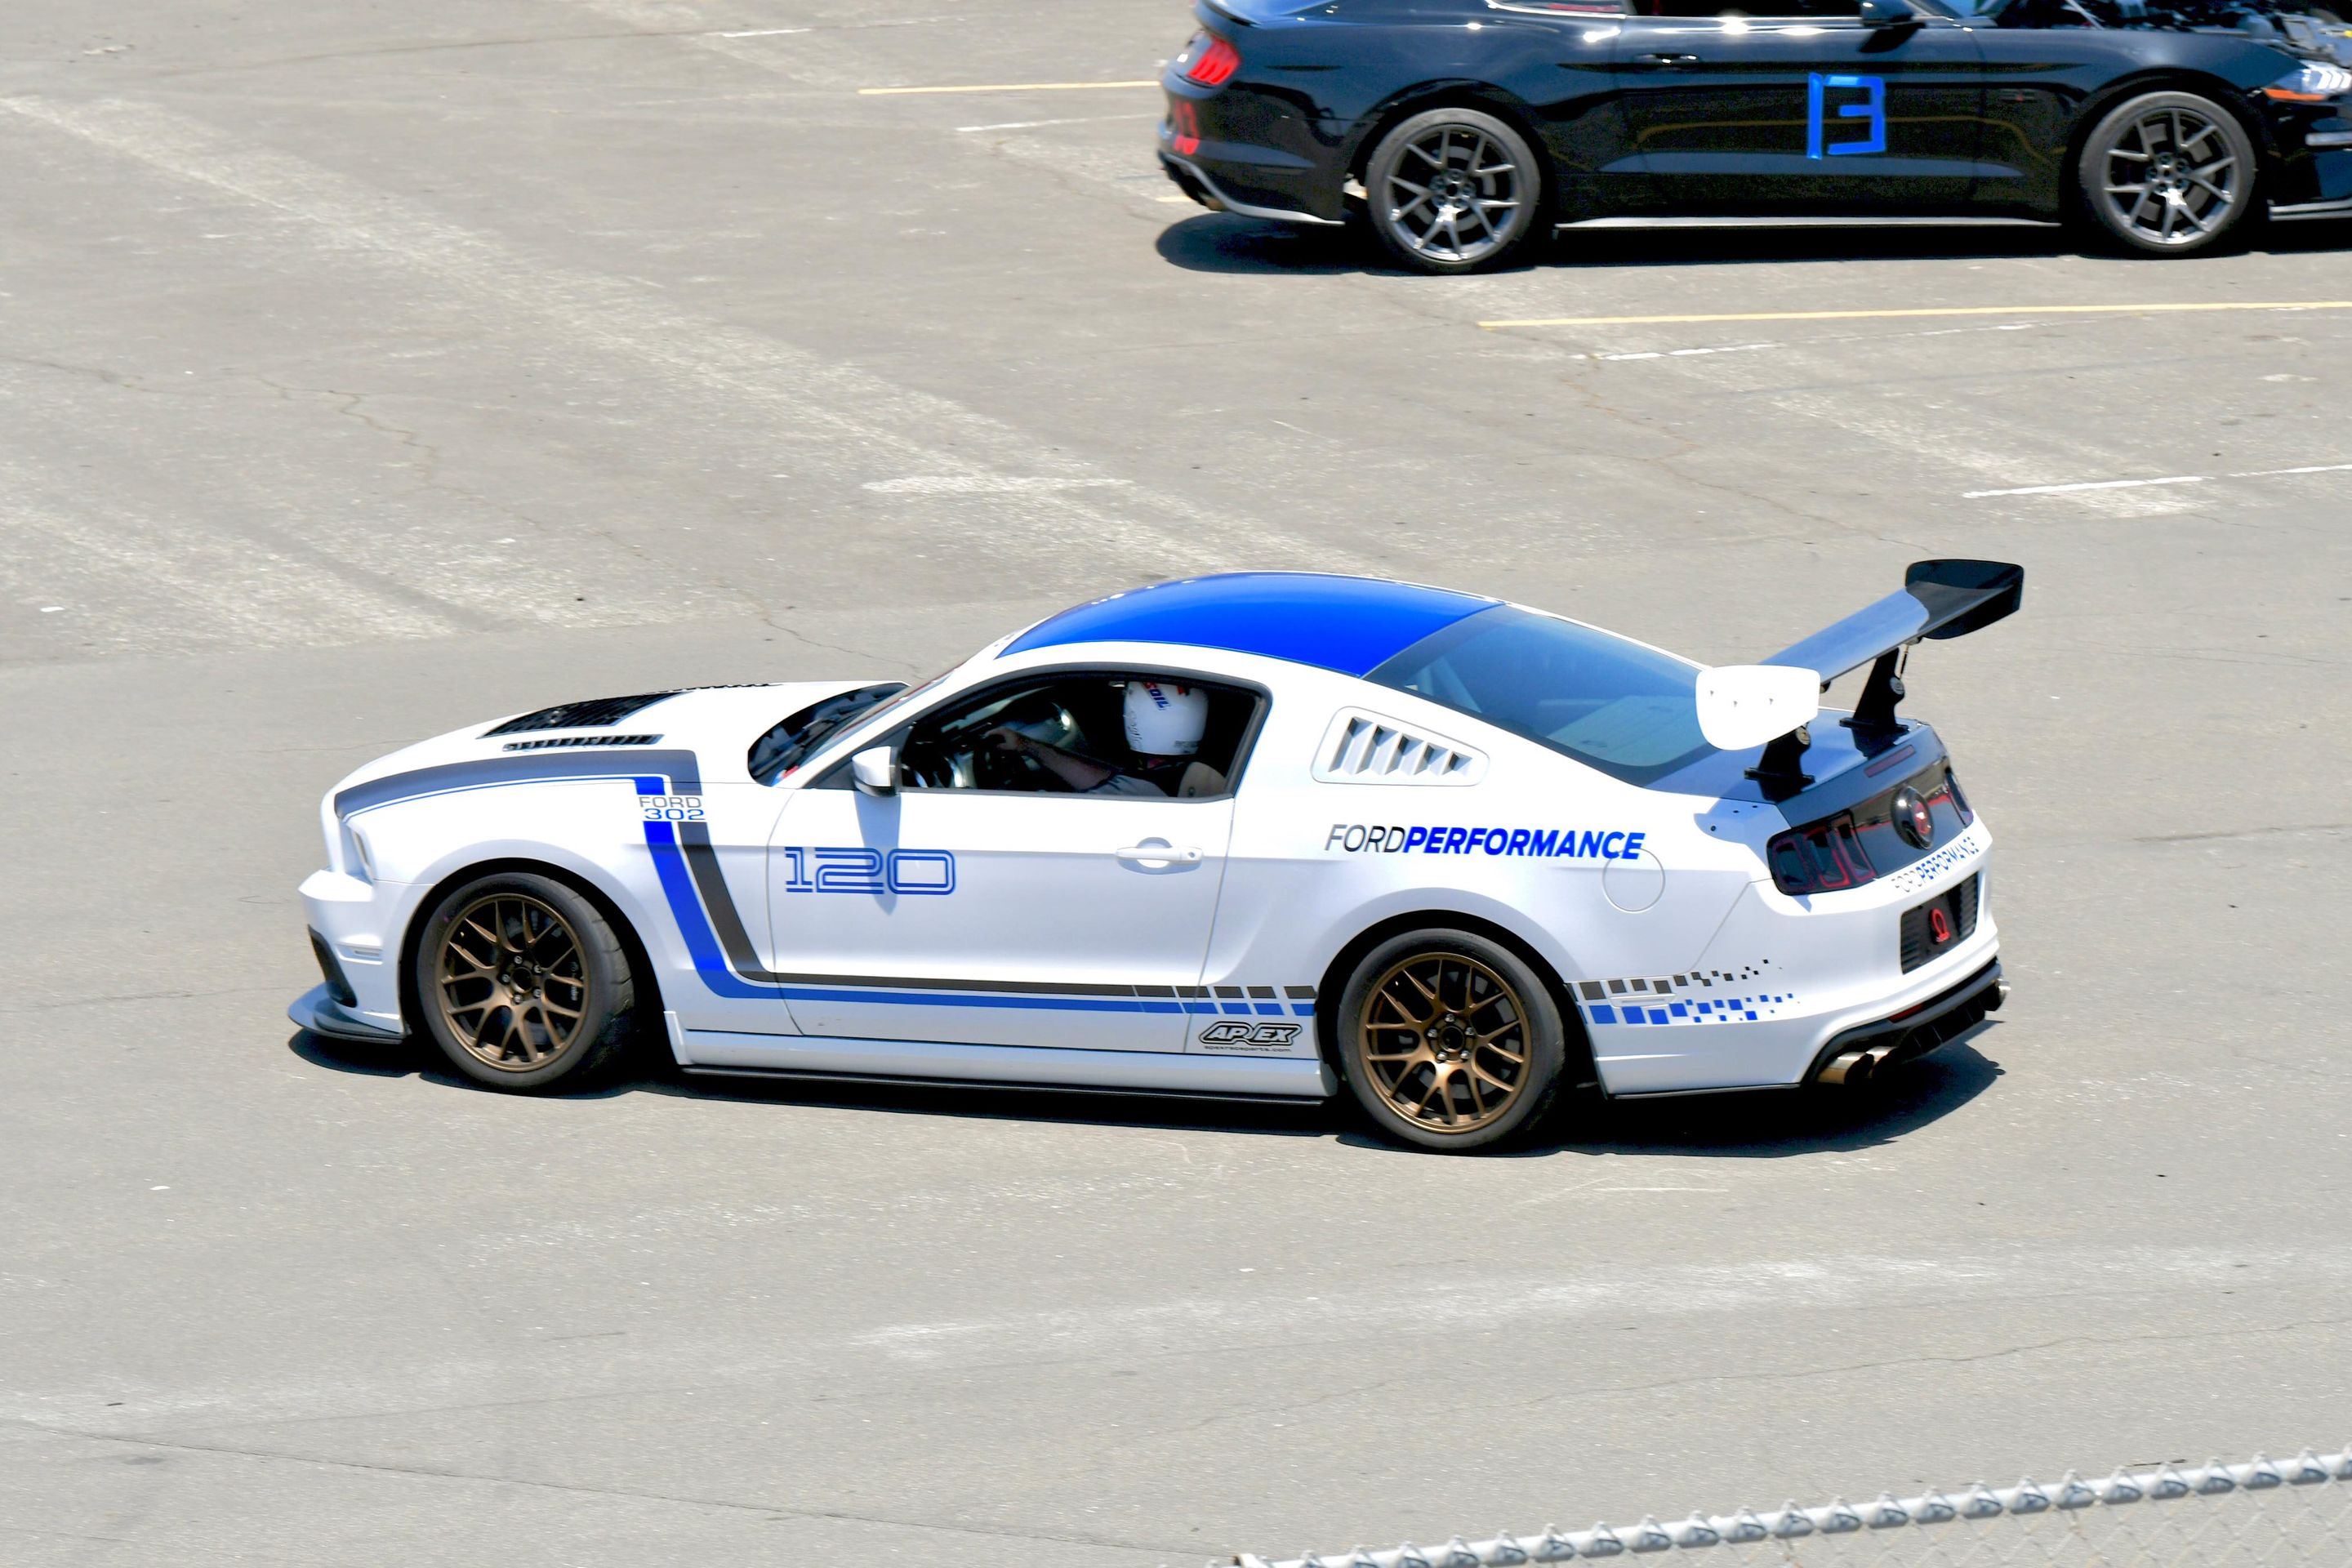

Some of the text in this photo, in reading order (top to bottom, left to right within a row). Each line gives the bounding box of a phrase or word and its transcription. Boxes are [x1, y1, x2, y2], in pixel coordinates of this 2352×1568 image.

[639, 796, 702, 808] FORD
[644, 808, 706, 821] 302
[785, 847, 956, 895] 120
[1202, 1023, 1298, 1044] APEX
